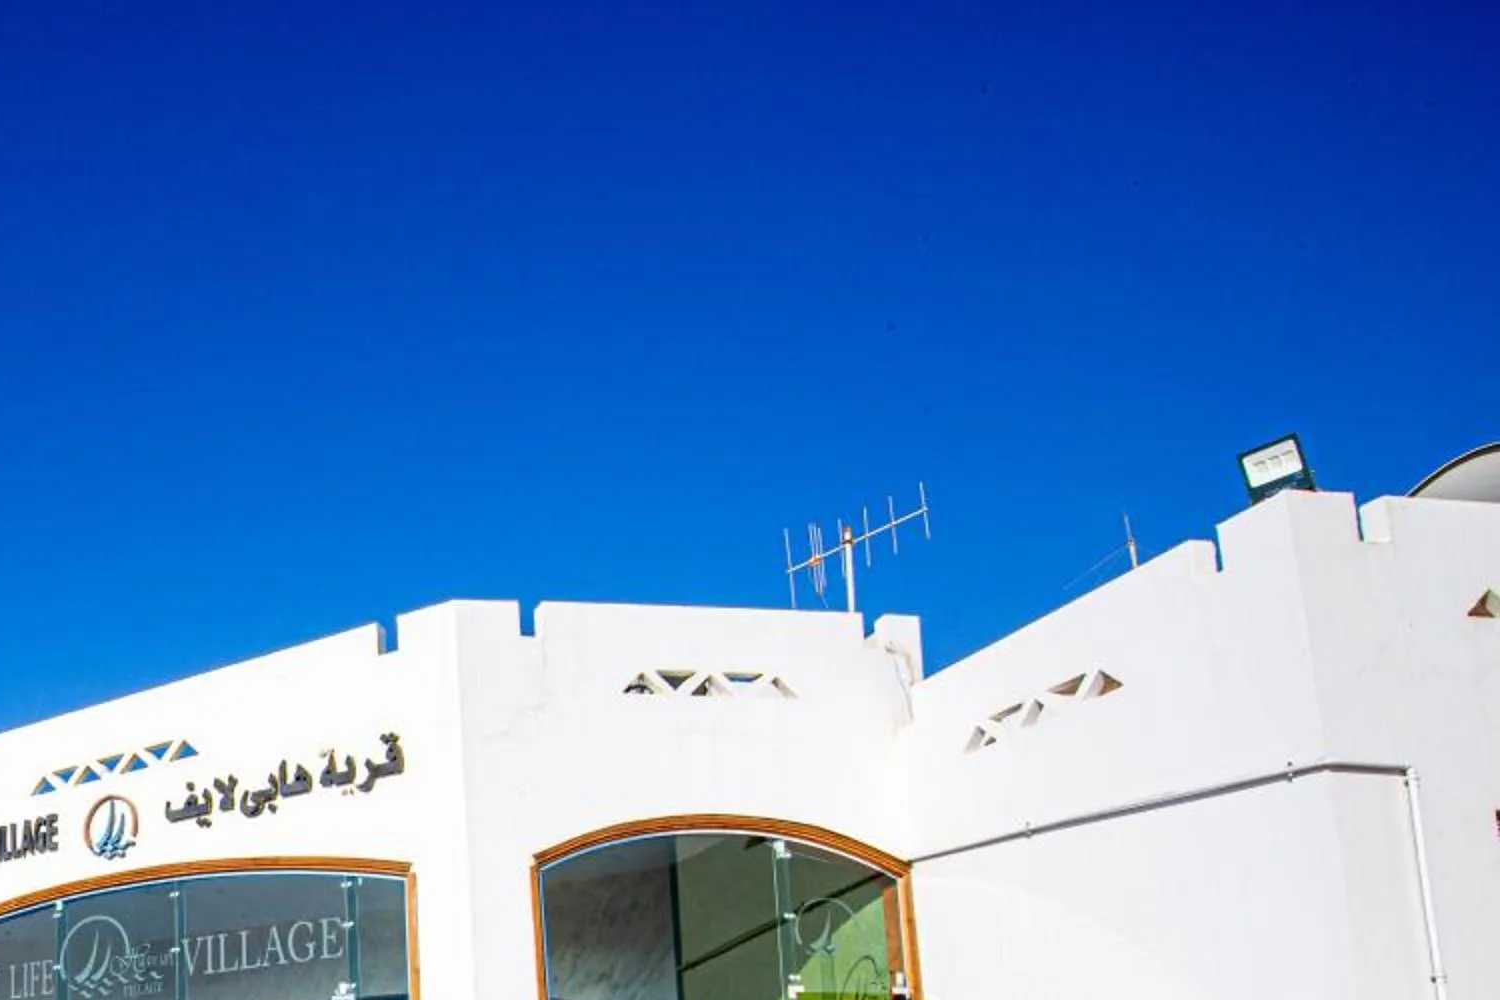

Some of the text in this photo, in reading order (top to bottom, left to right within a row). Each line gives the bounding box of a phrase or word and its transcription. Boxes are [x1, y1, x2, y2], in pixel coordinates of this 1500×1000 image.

[319, 732, 405, 796] قرية
[165, 774, 239, 828] لايف
[9, 959, 55, 1000] LIFE
[181, 916, 345, 977] VILLAGE
